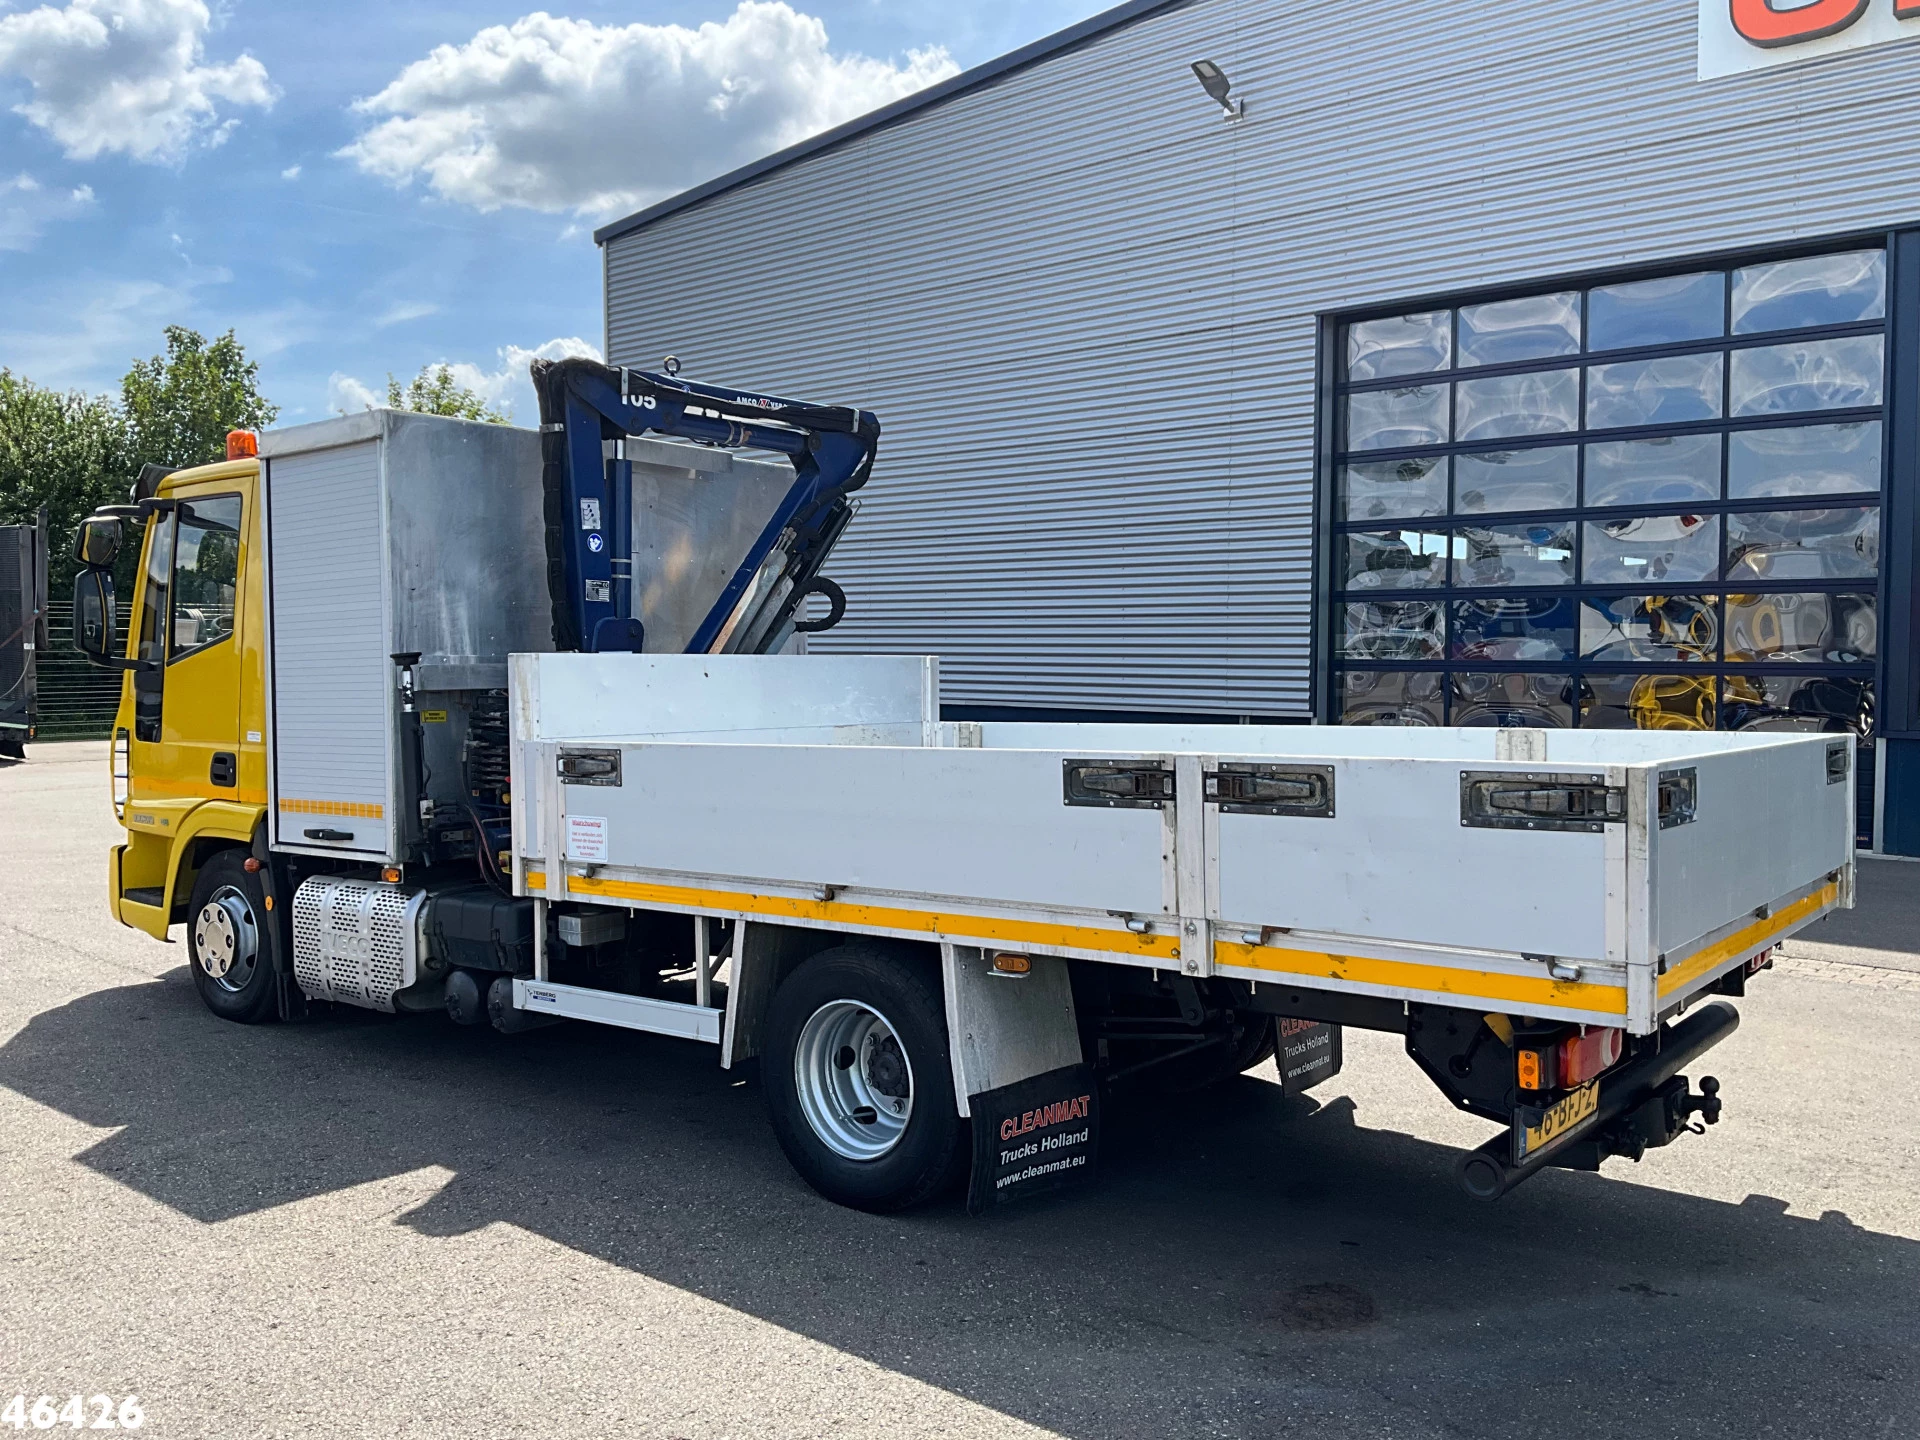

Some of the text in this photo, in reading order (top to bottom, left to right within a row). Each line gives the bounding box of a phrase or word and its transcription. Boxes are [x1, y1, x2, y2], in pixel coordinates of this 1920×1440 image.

[321, 931, 371, 958] IVECO
[1281, 1017, 1320, 1038] CLEAN
[1284, 1031, 1329, 1059] Trucks Holland
[1287, 1054, 1330, 1079] www.cleanmat.eu
[1000, 1095, 1091, 1141] CLEANMAT
[1000, 1127, 1089, 1166] Trucks Holland
[996, 1155, 1086, 1189] www.cleanmat.eu
